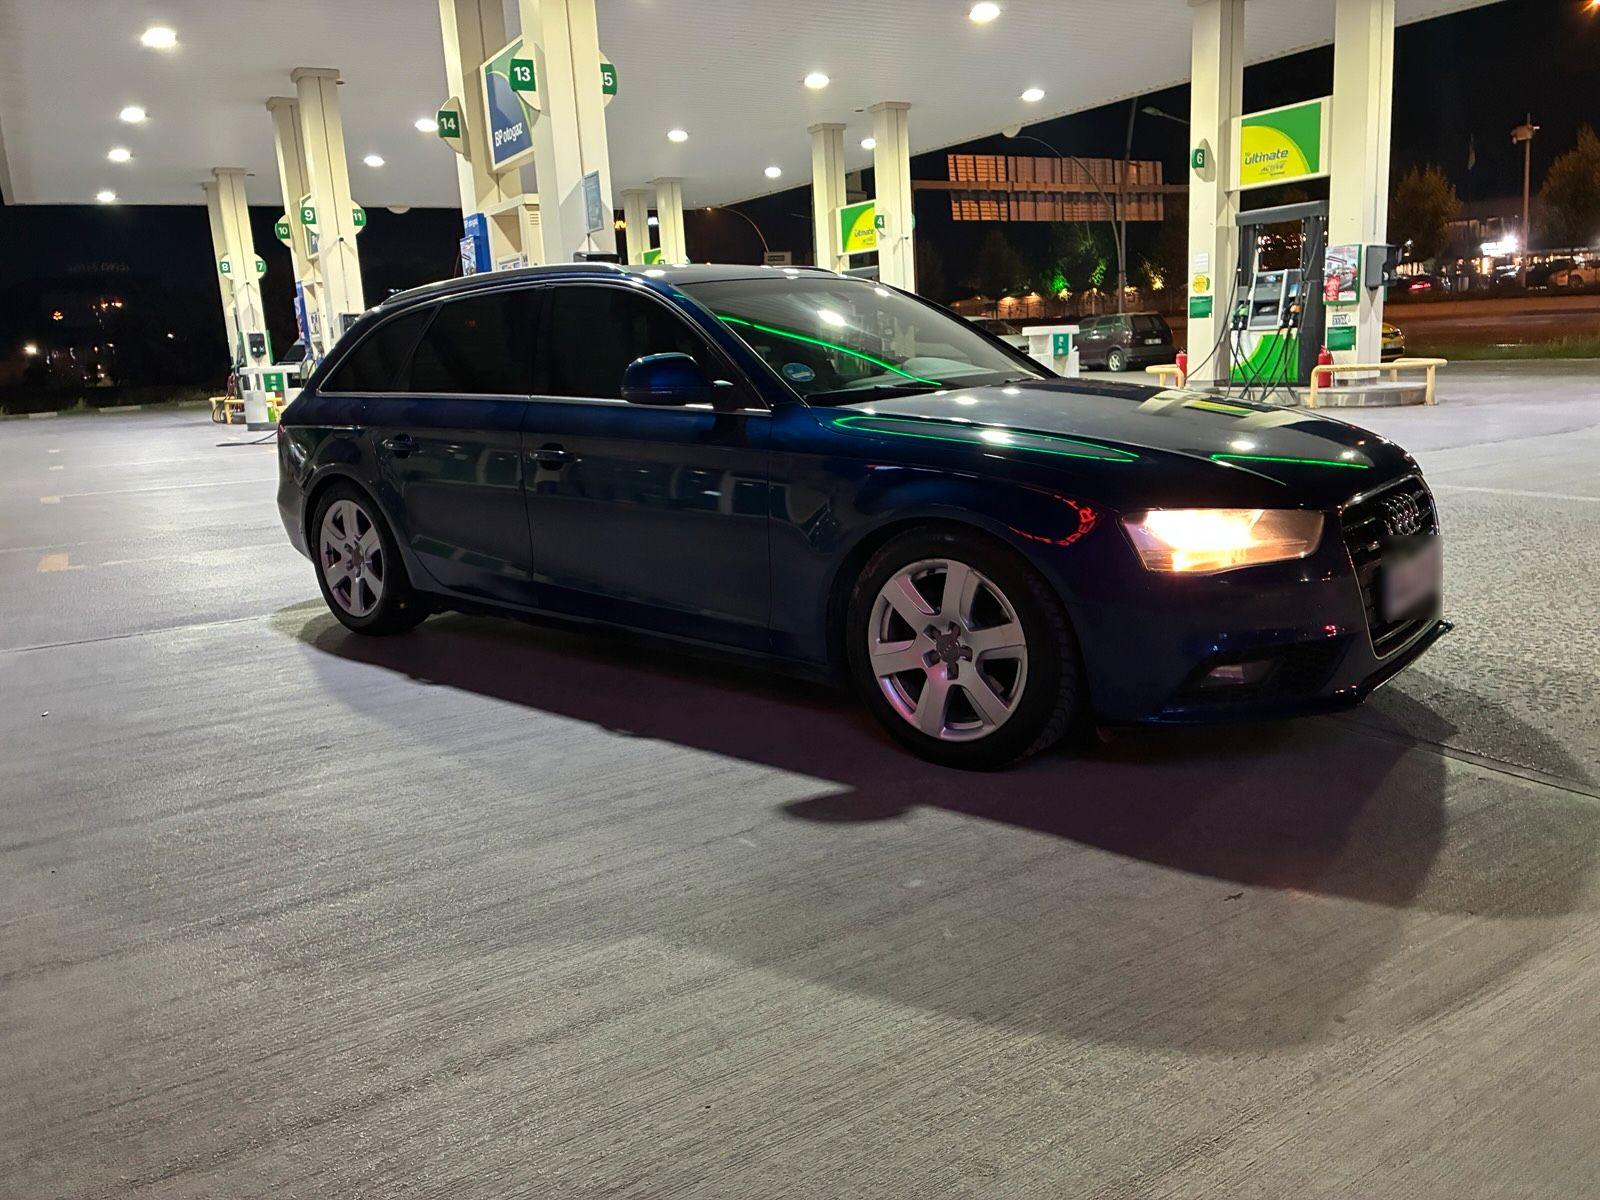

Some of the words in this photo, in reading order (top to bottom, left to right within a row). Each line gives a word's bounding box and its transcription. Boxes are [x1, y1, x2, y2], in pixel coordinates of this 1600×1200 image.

[513, 66, 531, 82] 13
[440, 117, 456, 130] 14
[494, 129, 503, 147] BP
[503, 122, 523, 142] otogaz
[1196, 152, 1204, 165] 6
[1244, 148, 1289, 165] ultimate
[304, 209, 314, 221] 9
[353, 212, 362, 221] 11
[877, 216, 883, 226] 4
[278, 226, 288, 235] 10
[221, 262, 230, 272] 8
[257, 262, 264, 271] 7
